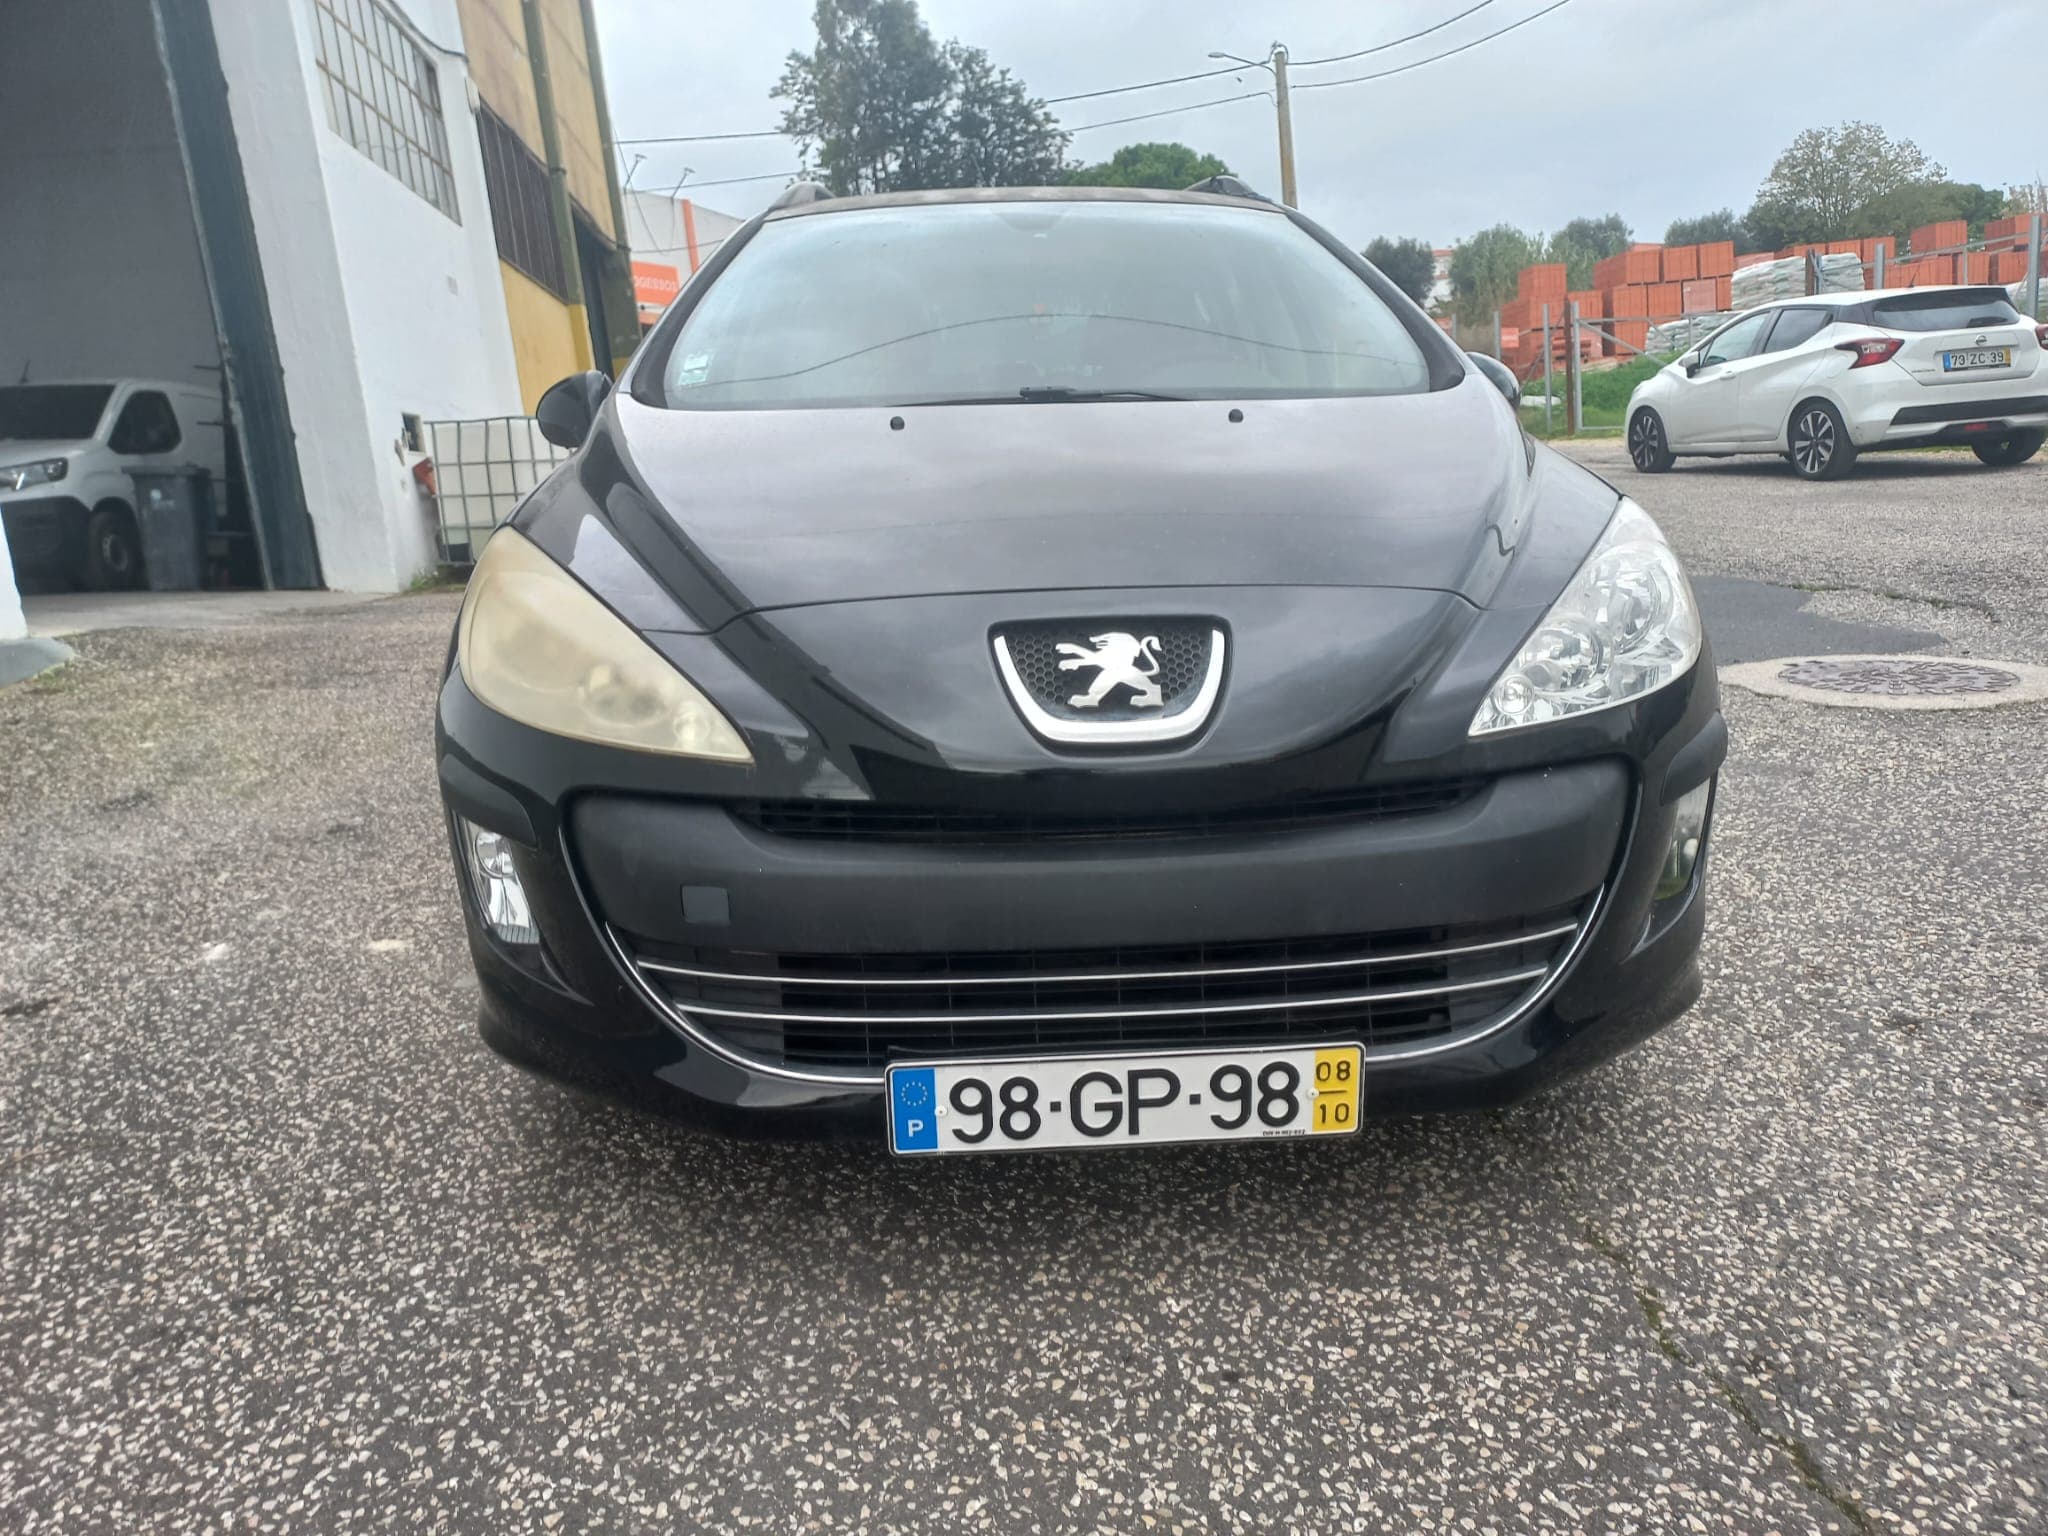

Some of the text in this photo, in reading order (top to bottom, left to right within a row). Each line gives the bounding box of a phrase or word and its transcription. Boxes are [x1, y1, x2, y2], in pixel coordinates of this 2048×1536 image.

[1316, 1061, 1351, 1082] 08
[1319, 1103, 1350, 1124] 10
[907, 1120, 924, 1138] P
